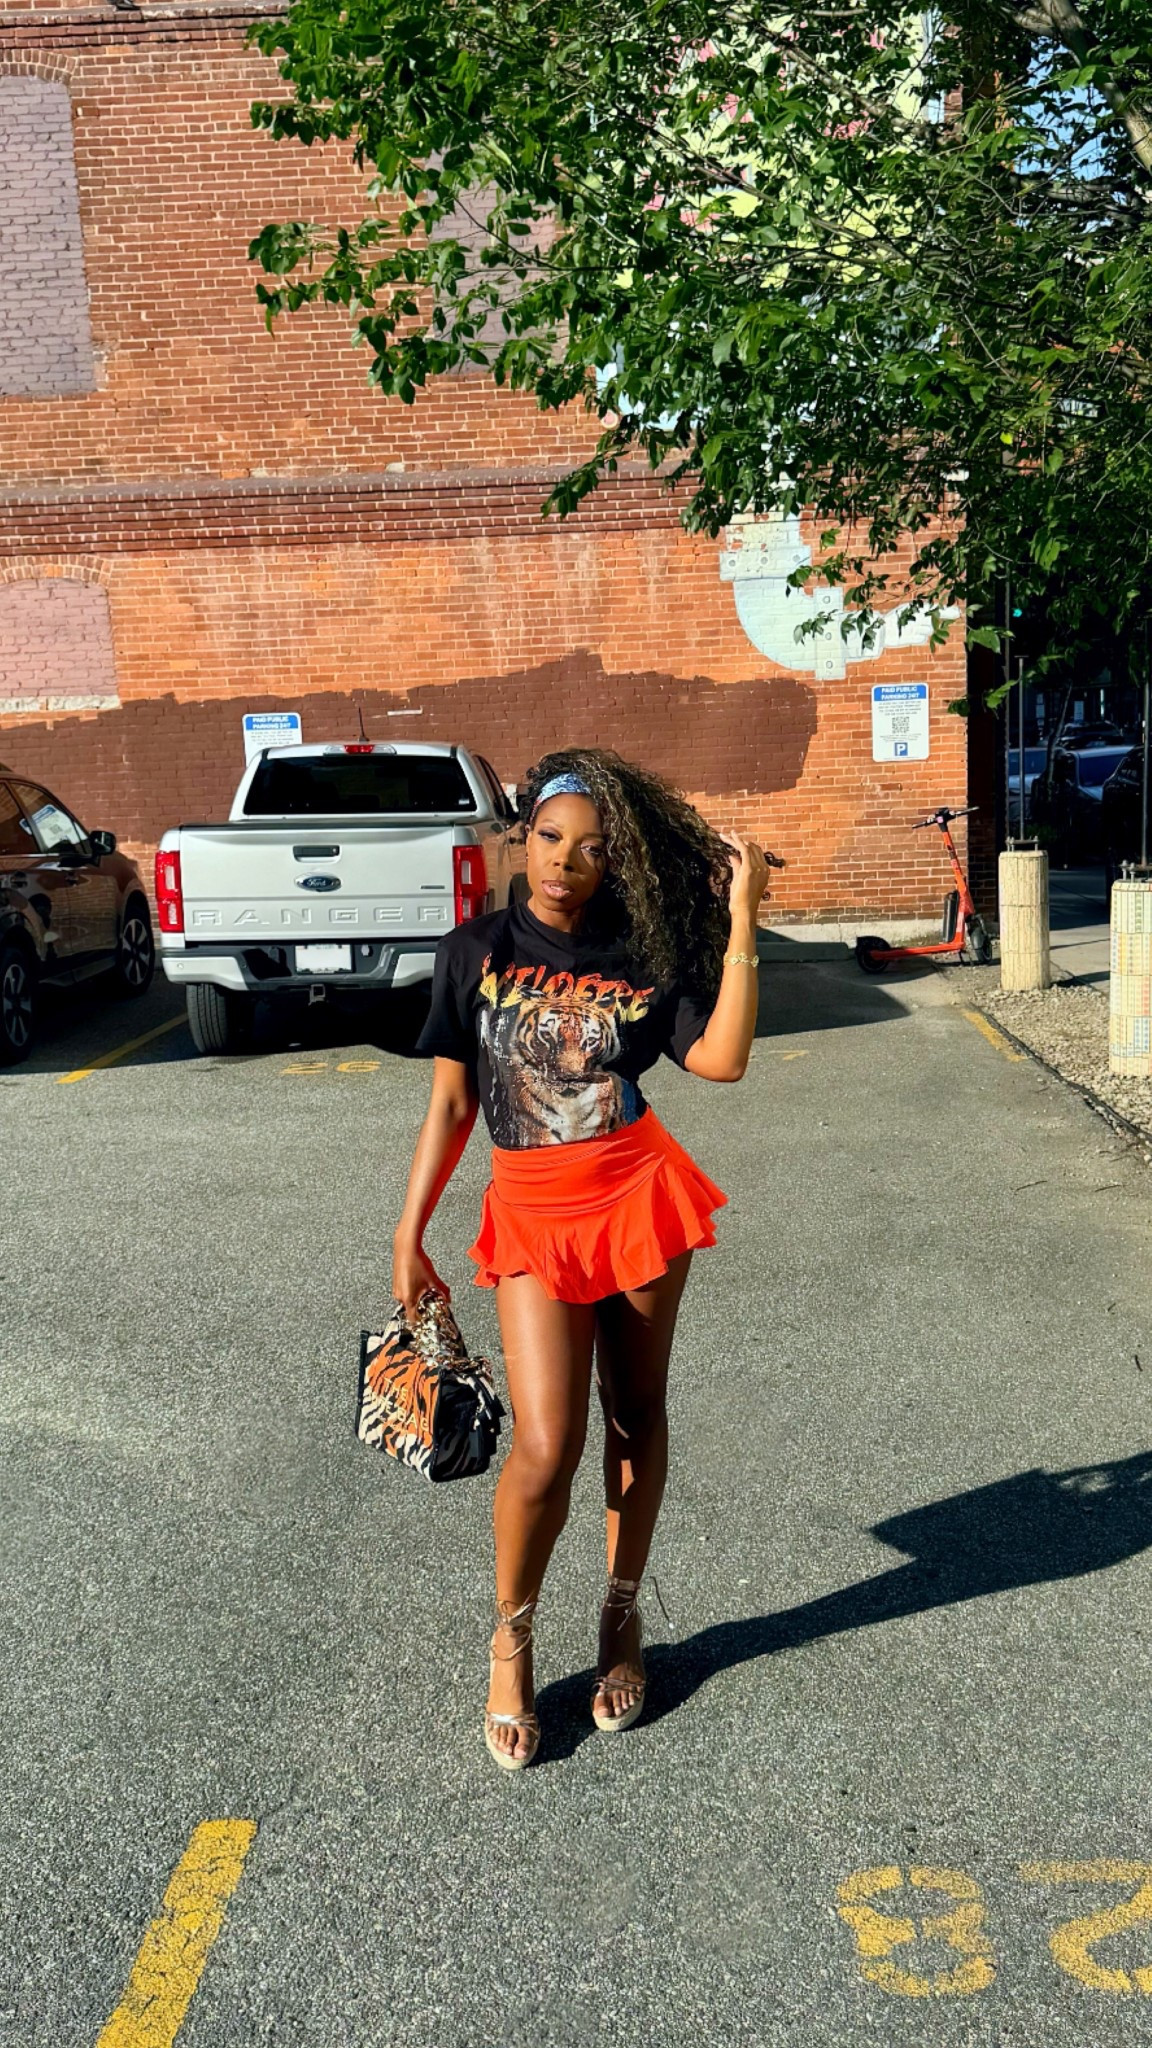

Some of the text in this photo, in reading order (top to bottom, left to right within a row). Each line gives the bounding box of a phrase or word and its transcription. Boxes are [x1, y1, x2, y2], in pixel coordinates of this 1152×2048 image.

[896, 743, 906, 756] P
[307, 878, 326, 887] Ford
[192, 905, 448, 926] RANGER
[282, 1061, 382, 1075] 26
[384, 1377, 408, 1401] THE
[397, 1406, 429, 1432] BAG
